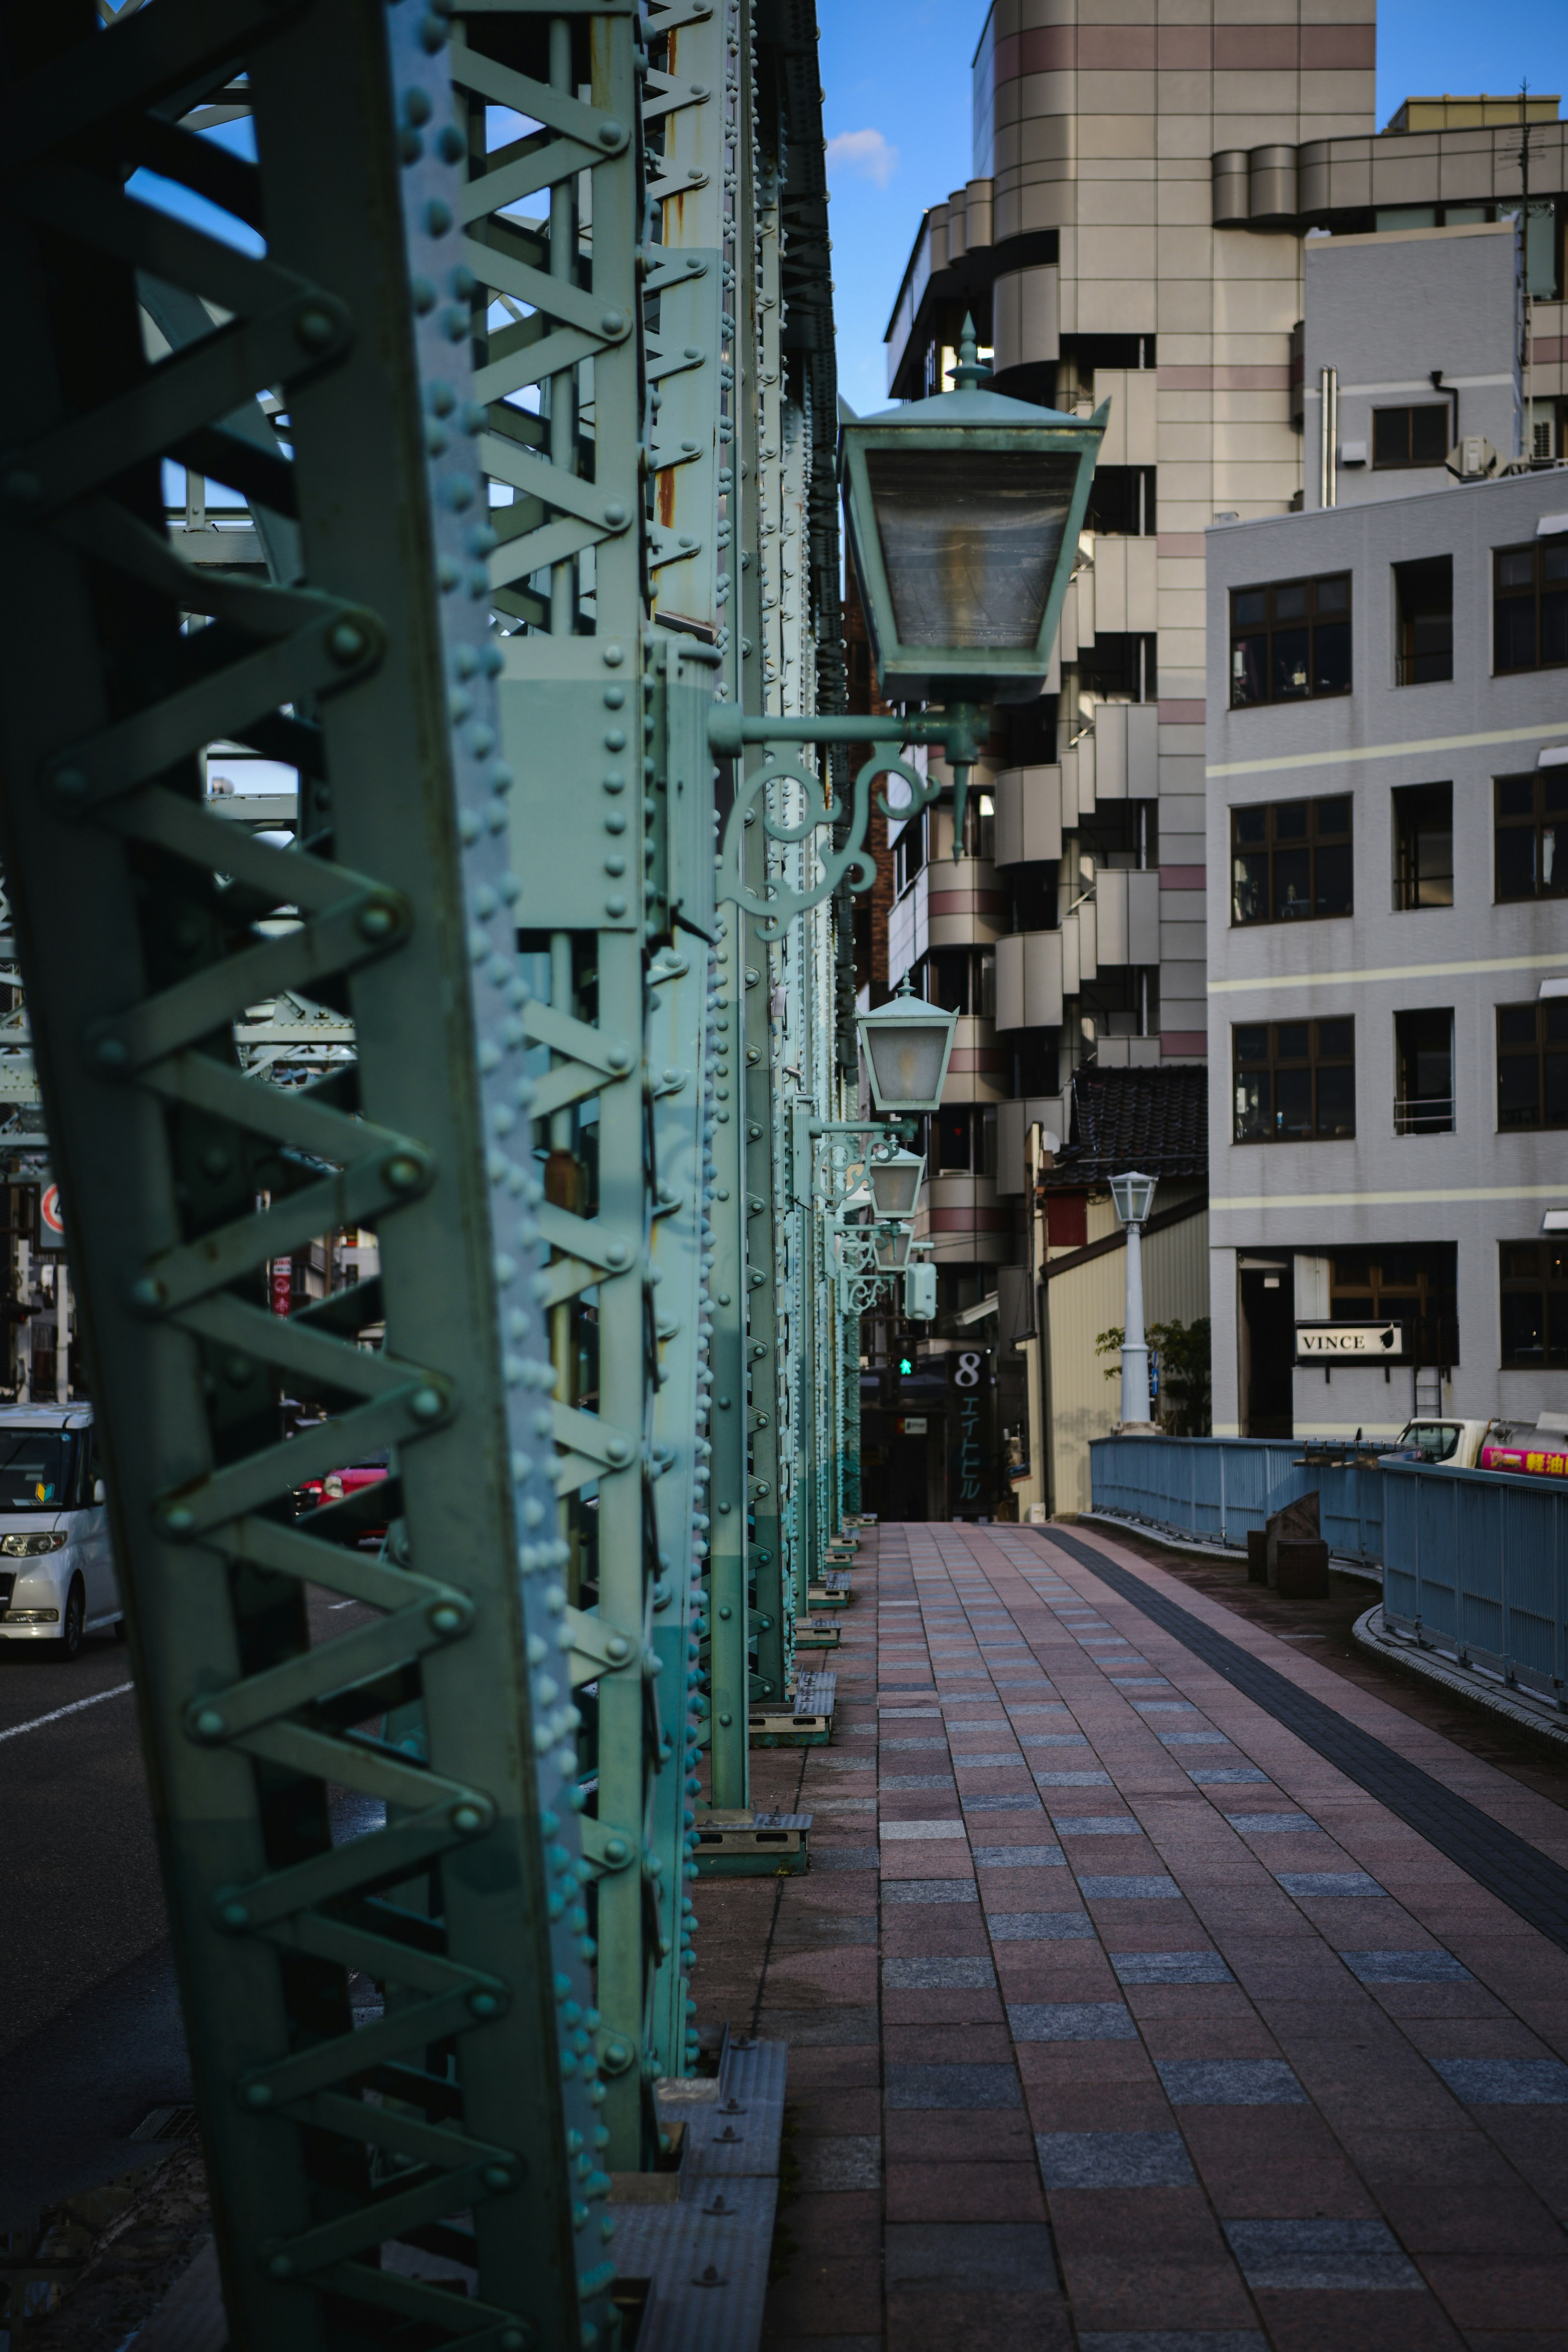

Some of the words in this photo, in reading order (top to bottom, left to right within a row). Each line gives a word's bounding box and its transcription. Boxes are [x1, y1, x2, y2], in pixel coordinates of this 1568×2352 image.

[1303, 1335, 1365, 1349] VINCE
[955, 1352, 981, 1387] 8
[960, 1397, 981, 1499] エイトビル
[1526, 1452, 1568, 1475] 軽油
